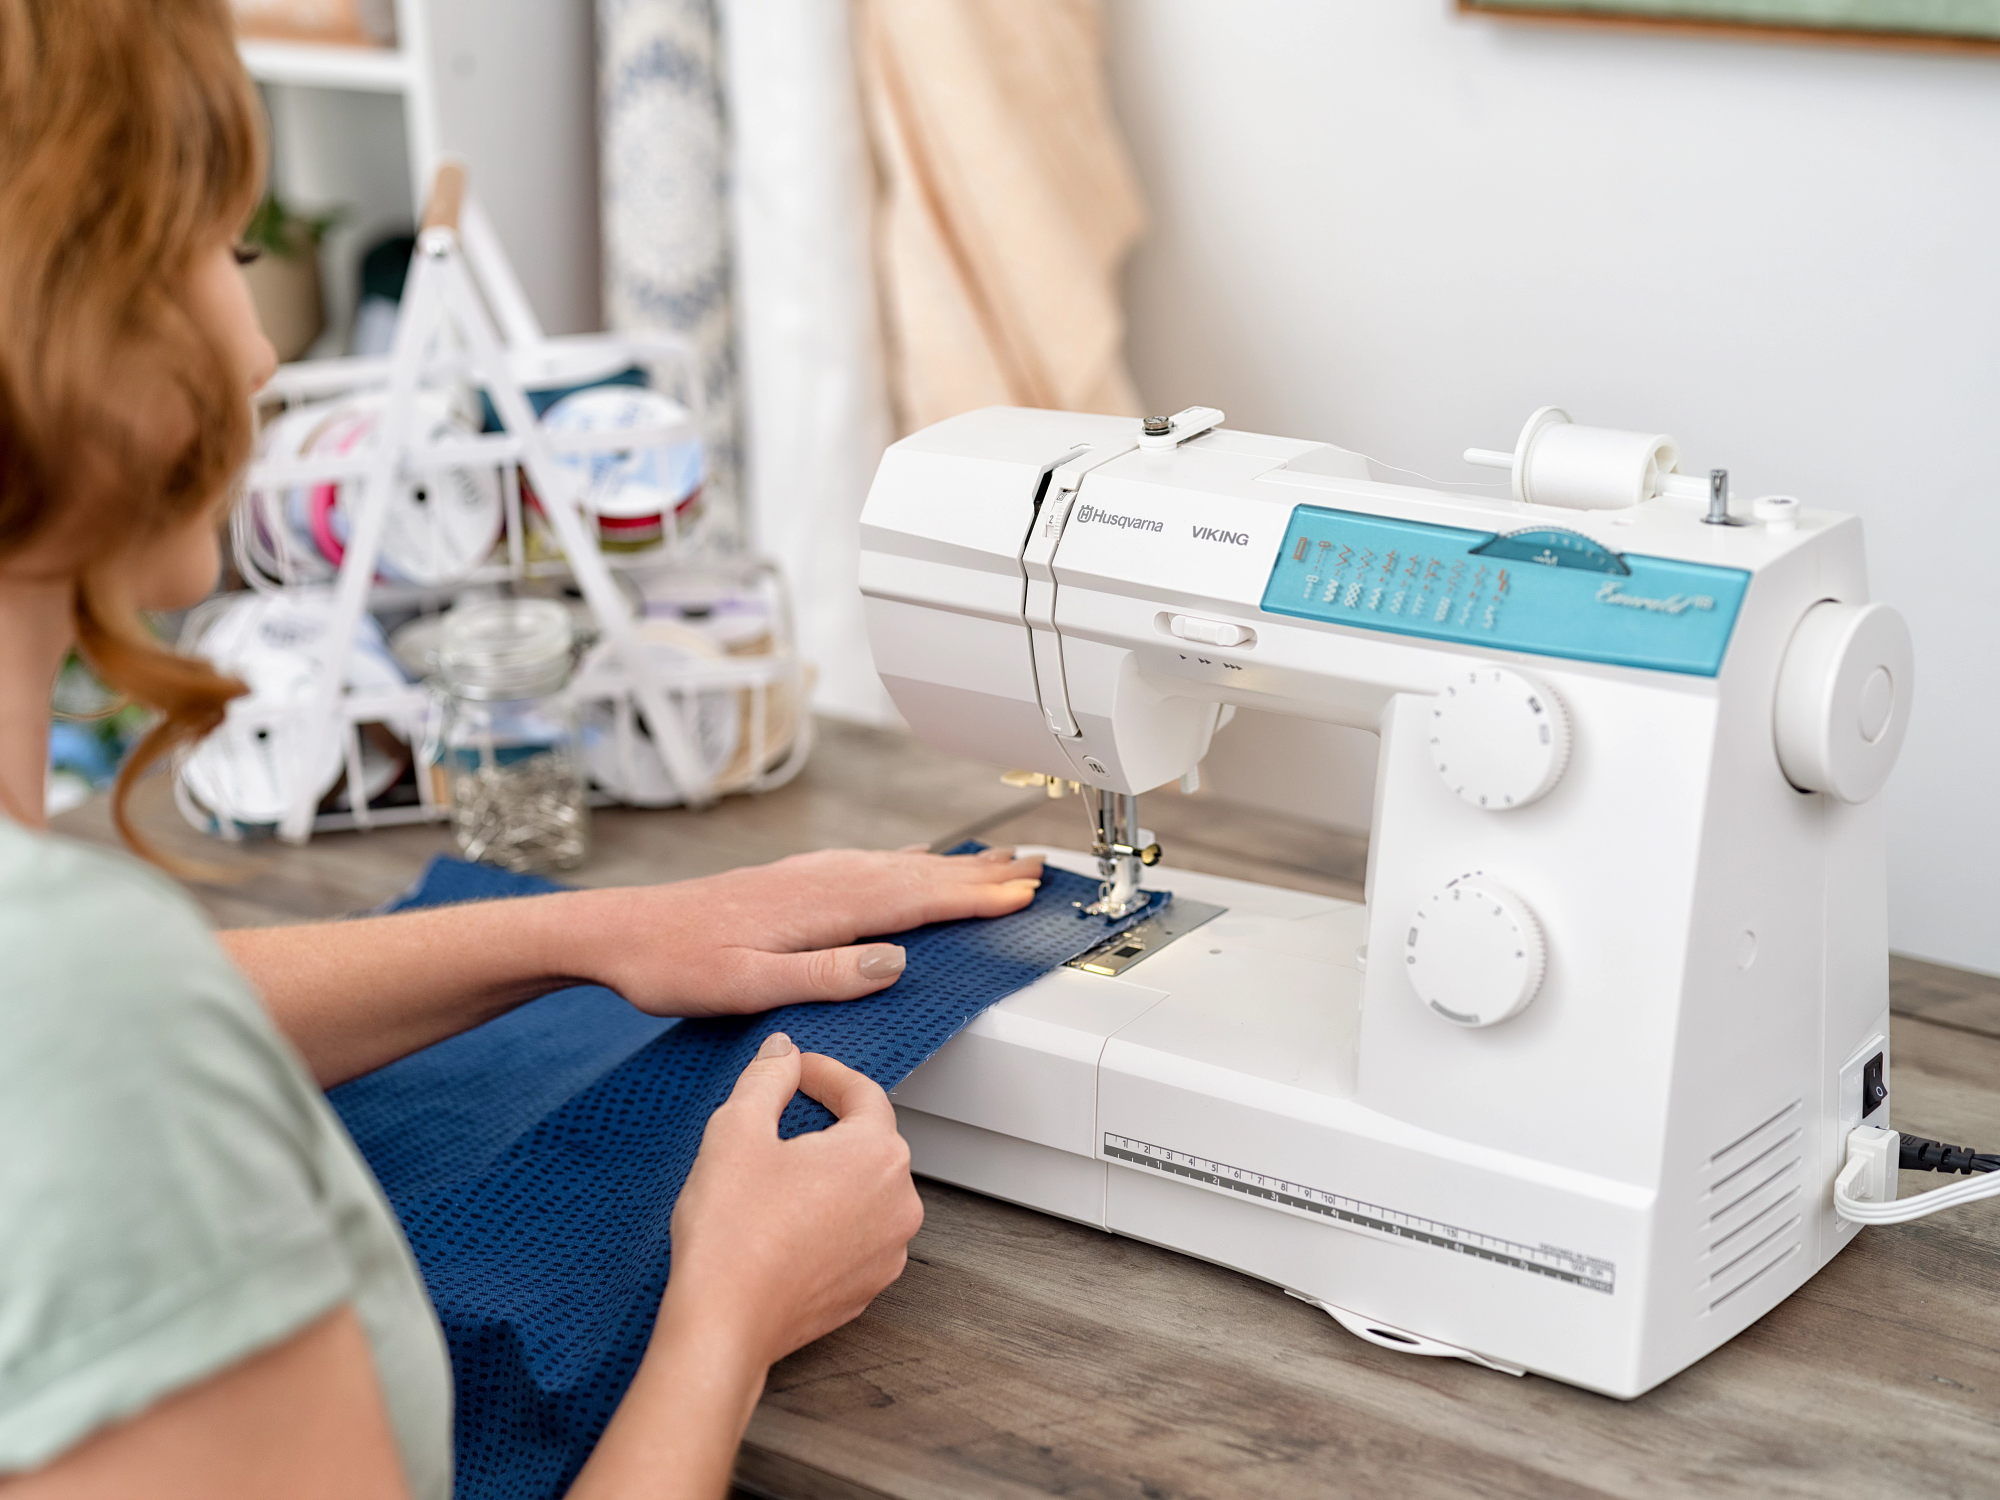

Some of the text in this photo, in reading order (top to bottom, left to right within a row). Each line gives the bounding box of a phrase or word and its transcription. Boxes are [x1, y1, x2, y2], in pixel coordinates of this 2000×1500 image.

[1091, 508, 1164, 533] Husqvarna
[1191, 525, 1250, 547] VIKING
[1595, 581, 1692, 615] Emerald
[1143, 1145, 1150, 1154] 2
[1166, 1151, 1172, 1160] 3
[1188, 1157, 1194, 1166] 4
[1211, 1163, 1217, 1172] 5
[1234, 1170, 1240, 1179] 6
[1257, 1176, 1263, 1185] 7
[1280, 1182, 1286, 1192] 8
[1304, 1189, 1310, 1198] 9
[1323, 1194, 1334, 1204] 10
[1212, 1175, 1218, 1184] 2
[1270, 1192, 1276, 1201] 3
[1330, 1208, 1337, 1217] 4
[1391, 1225, 1398, 1235] 5
